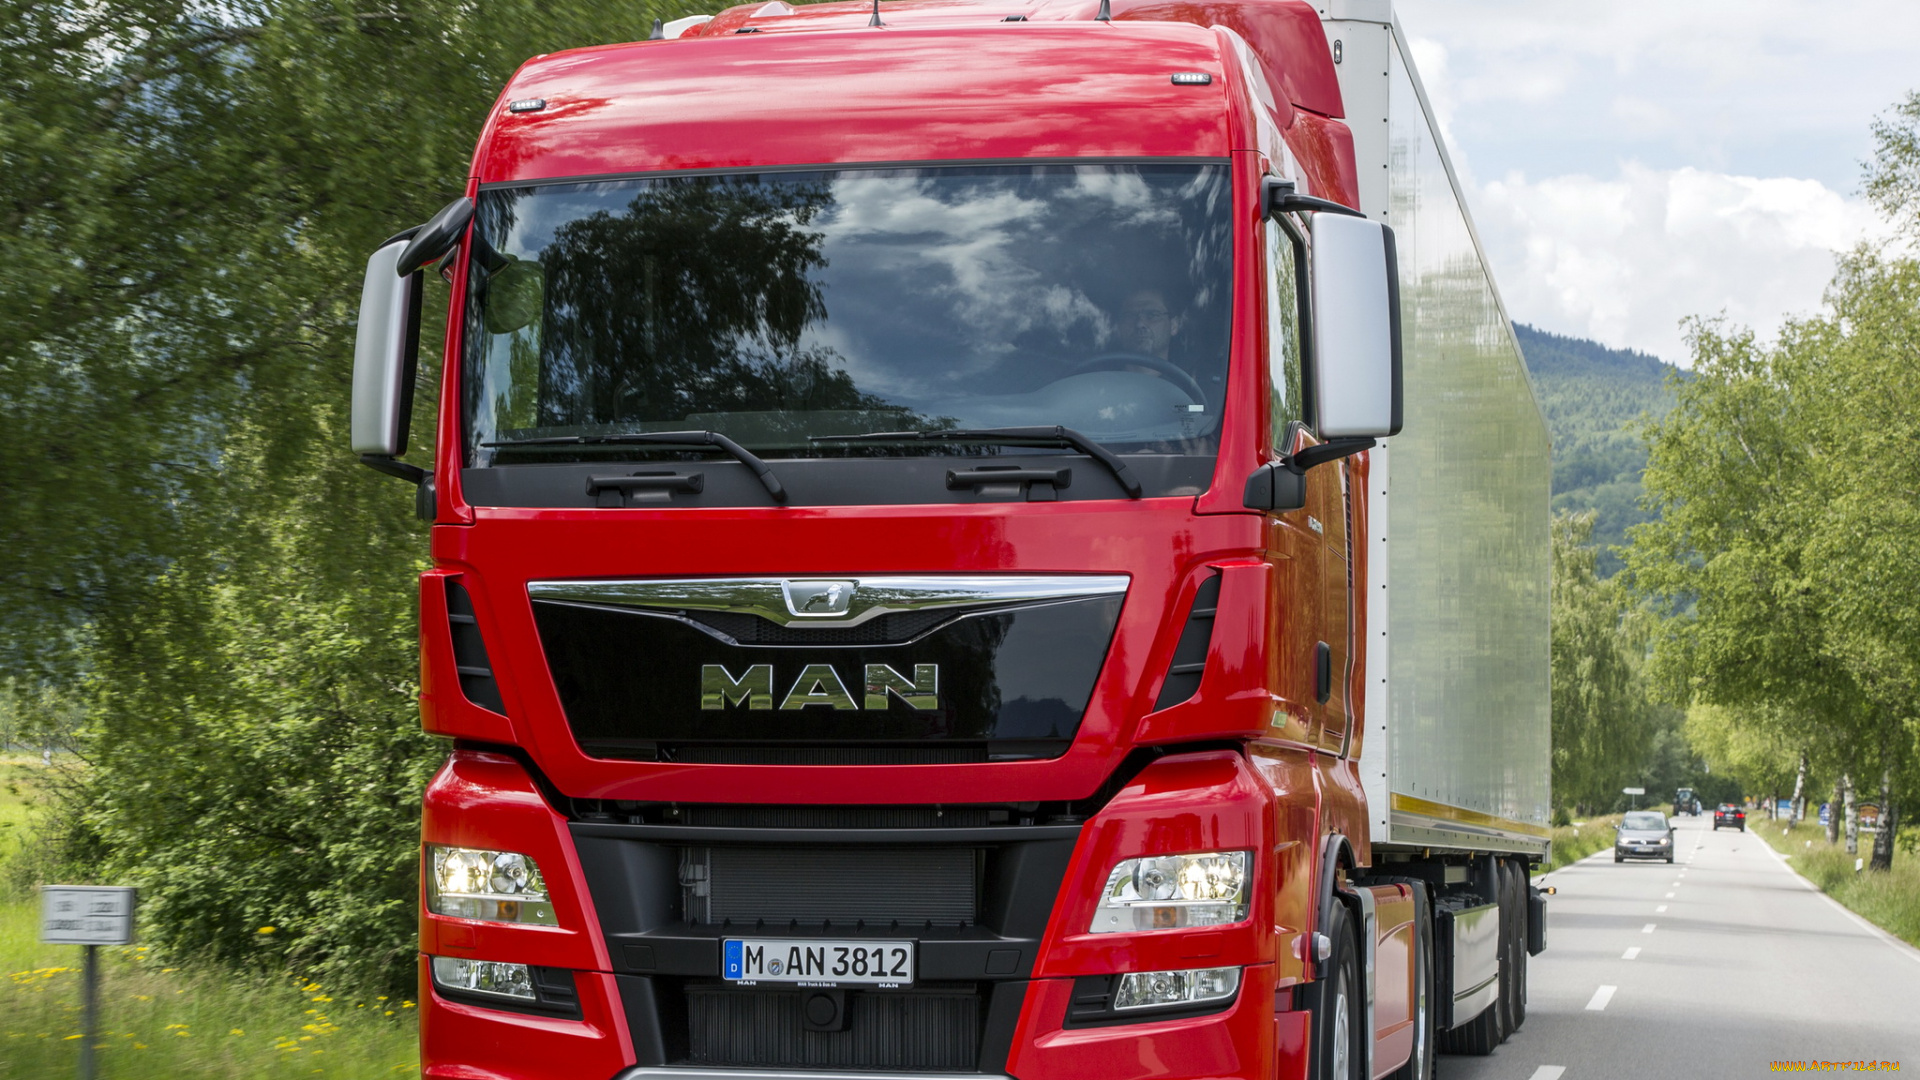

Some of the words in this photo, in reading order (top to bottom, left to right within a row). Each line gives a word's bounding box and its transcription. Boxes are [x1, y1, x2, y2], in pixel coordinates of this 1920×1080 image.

[701, 663, 939, 710] MAN
[730, 963, 738, 973] D
[745, 945, 764, 975] M
[786, 946, 825, 976] AN
[832, 947, 908, 977] 3812
